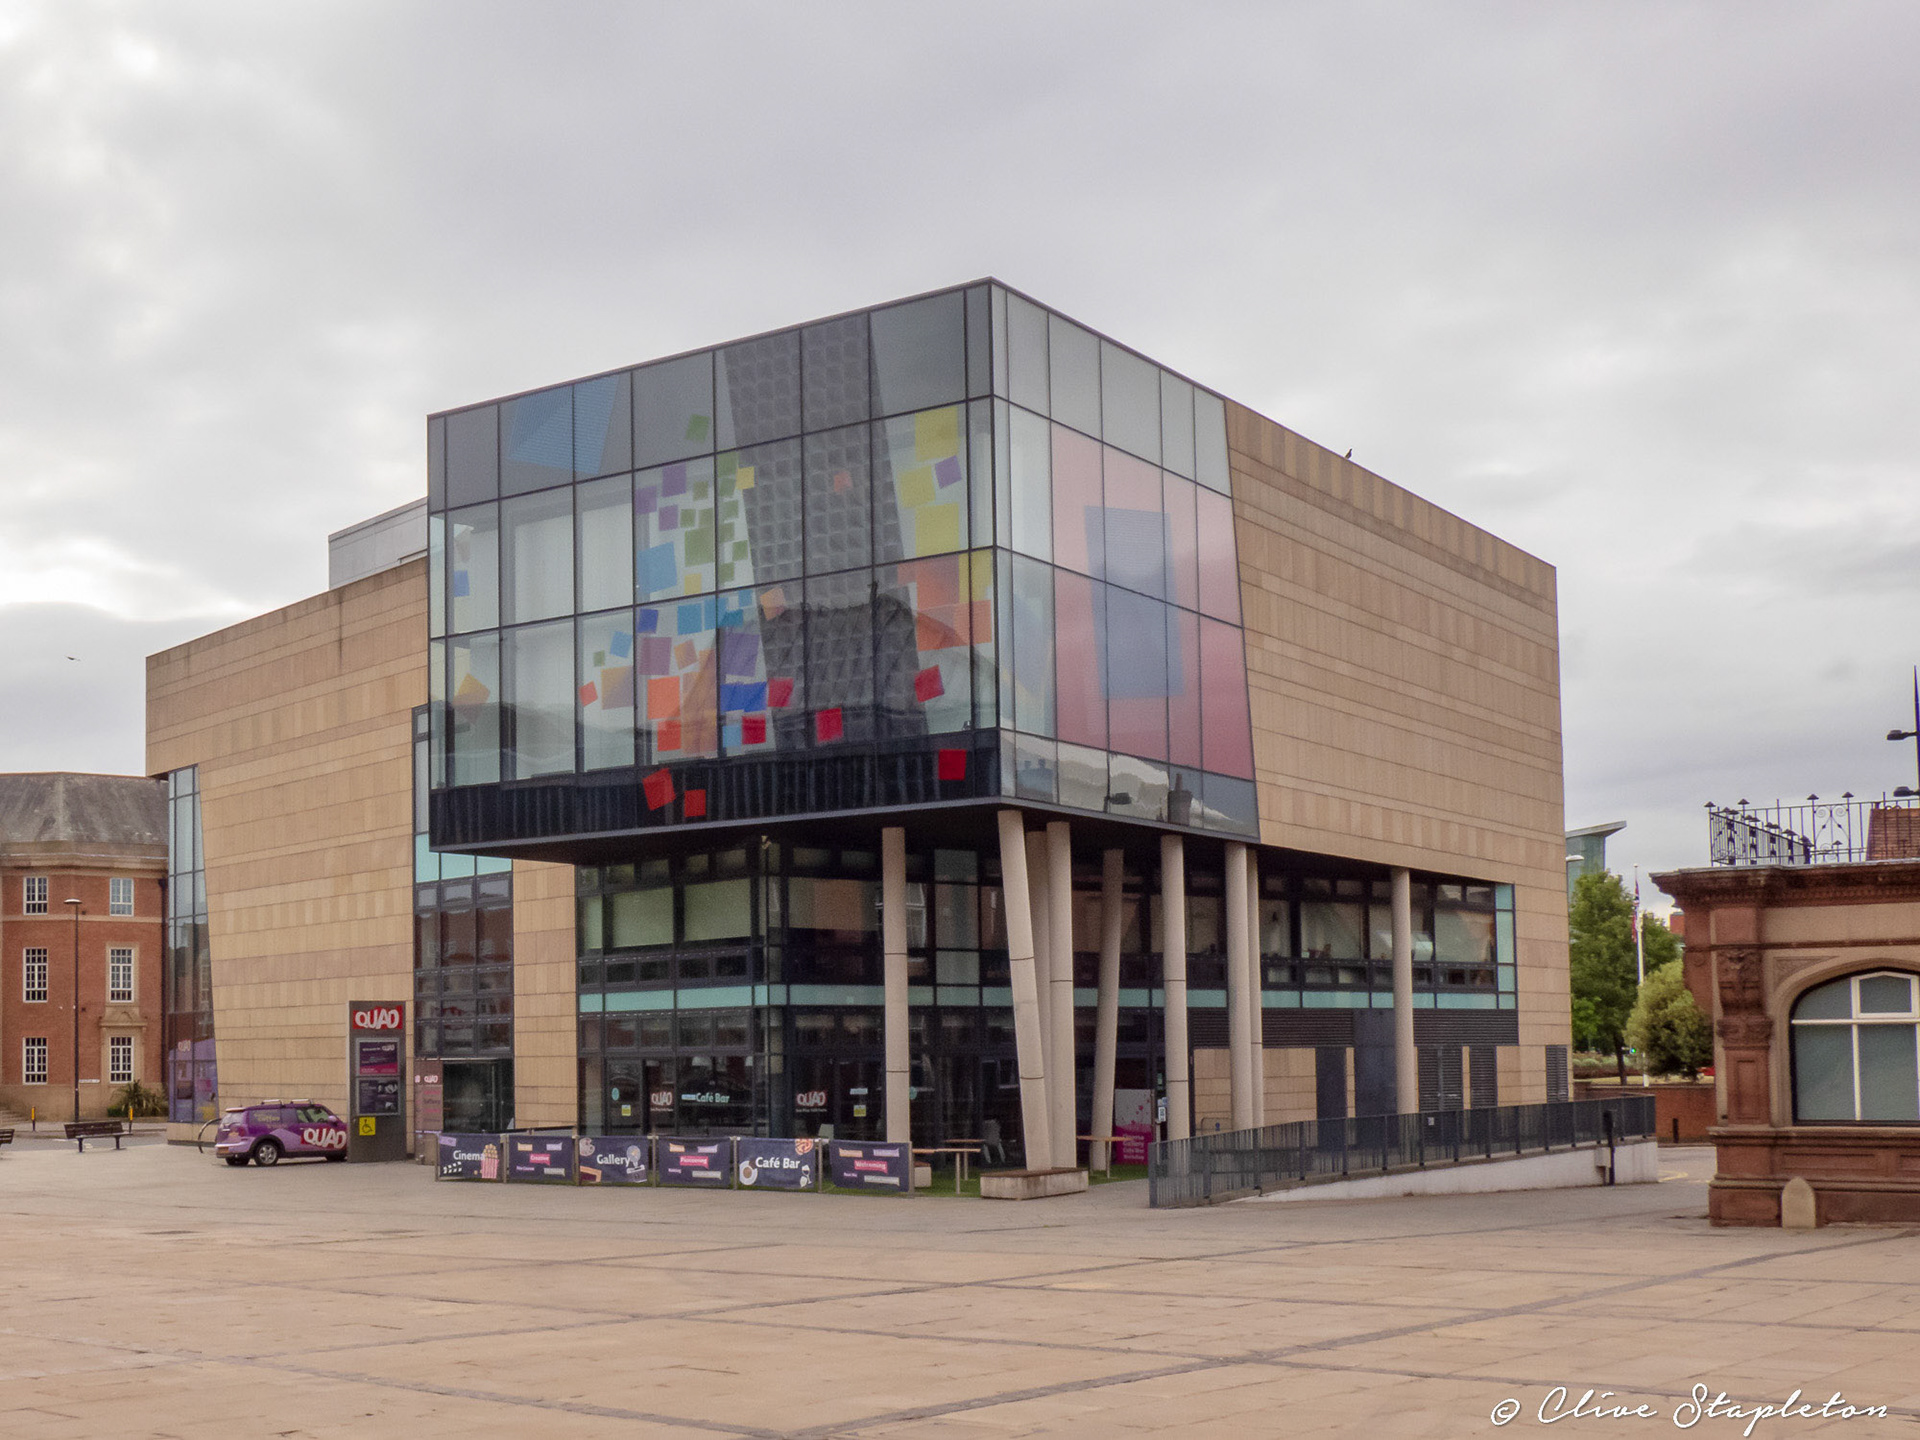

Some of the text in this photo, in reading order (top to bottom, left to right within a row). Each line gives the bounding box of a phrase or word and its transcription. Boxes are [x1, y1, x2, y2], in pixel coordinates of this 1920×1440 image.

[355, 1008, 400, 1030] QUAD
[651, 1092, 673, 1106] QUAD
[695, 1092, 714, 1103] Café
[714, 1092, 730, 1103] Bar
[796, 1091, 826, 1107] QUAD
[303, 1127, 347, 1149] QUAD
[452, 1150, 486, 1161] Cinema
[596, 1153, 631, 1168] Gallery
[755, 1156, 801, 1169] Café Bar
